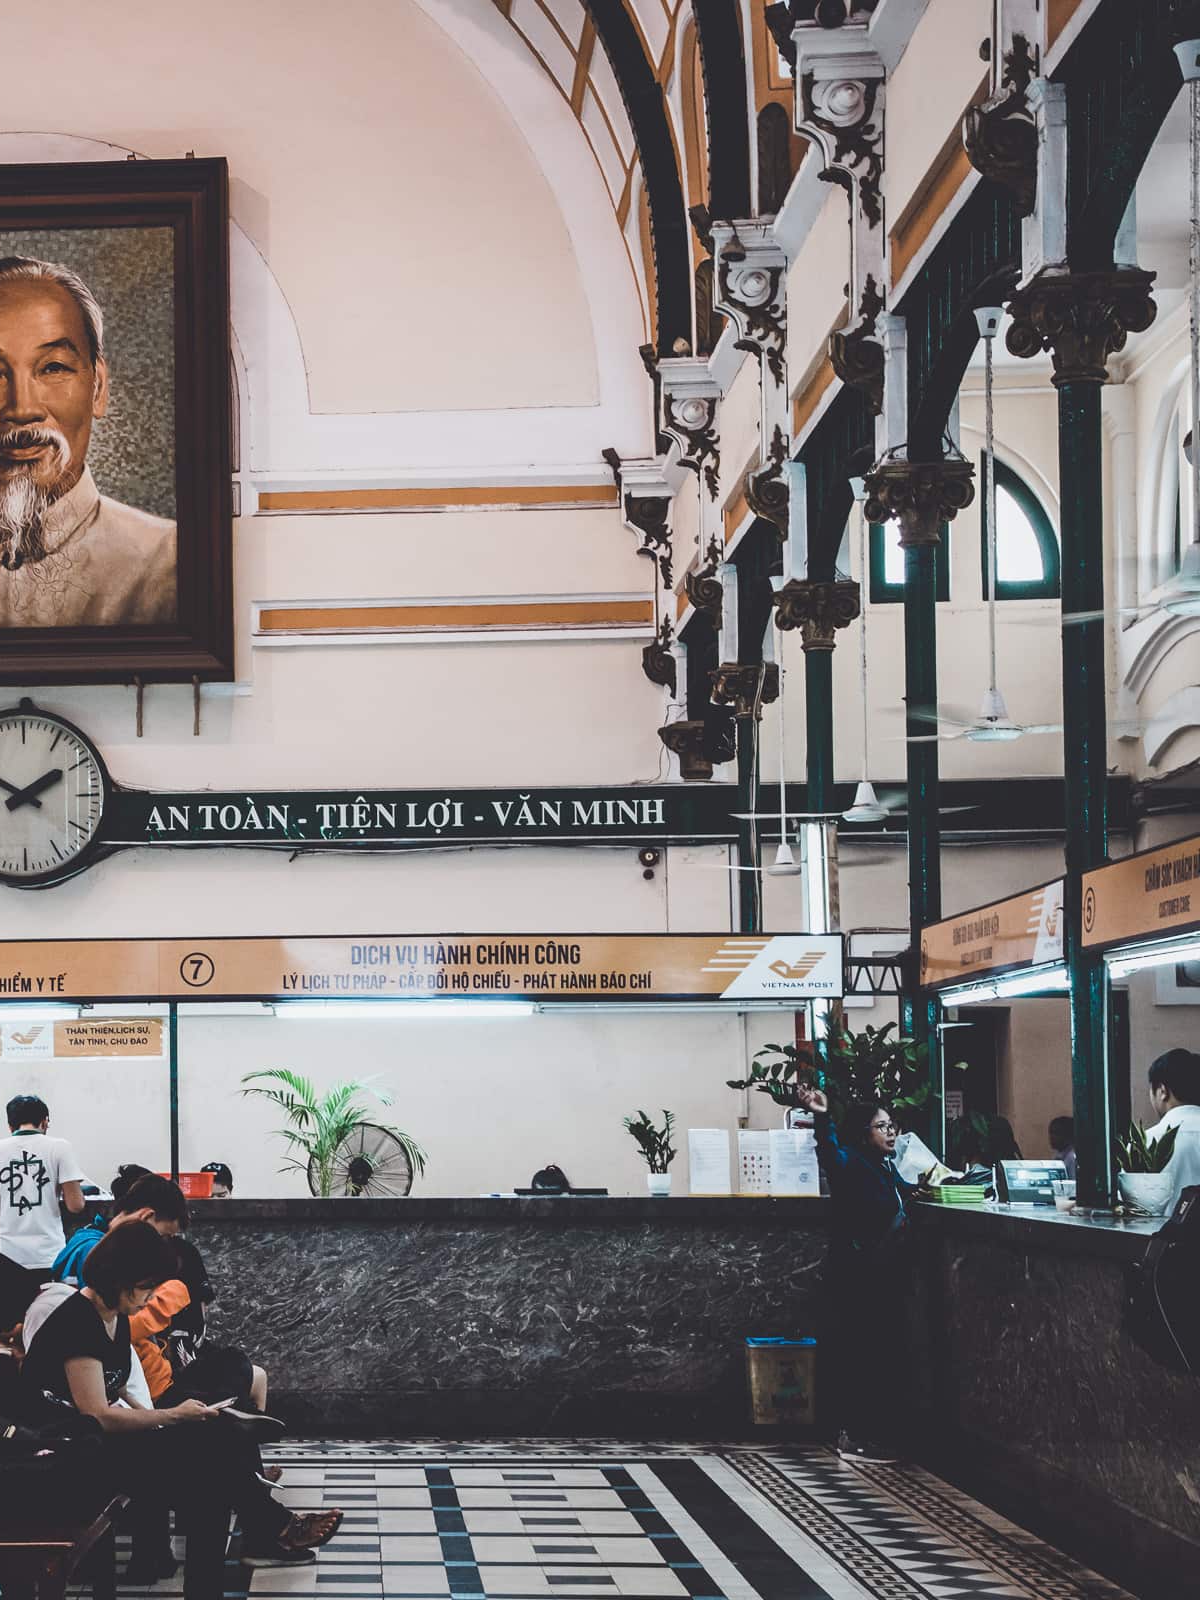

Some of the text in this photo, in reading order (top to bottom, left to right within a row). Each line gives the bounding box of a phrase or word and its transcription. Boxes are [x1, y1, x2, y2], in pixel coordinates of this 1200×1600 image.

[145, 806, 190, 831] AN
[198, 797, 289, 831] TOÀN
[316, 796, 396, 834] TIỆN
[406, 798, 464, 834] LỢI
[491, 794, 563, 827] VĂN
[571, 799, 666, 826] MINH
[351, 941, 581, 969] DỊCH VỤ HÀNH CHÍNH CÔNG
[36, 978, 45, 992] Y
[49, 972, 67, 992] TẾ
[283, 972, 298, 990] LÝ
[302, 974, 330, 992] LỊCH
[353, 971, 386, 990] PHÁP
[427, 968, 448, 989] ĐỔI
[452, 972, 469, 992] HỘ
[473, 970, 510, 989] CHIẾU
[523, 971, 557, 989] PHÁT
[560, 971, 597, 989] HÀNH
[600, 971, 626, 989] BÁO
[630, 971, 652, 989] CHÍ
